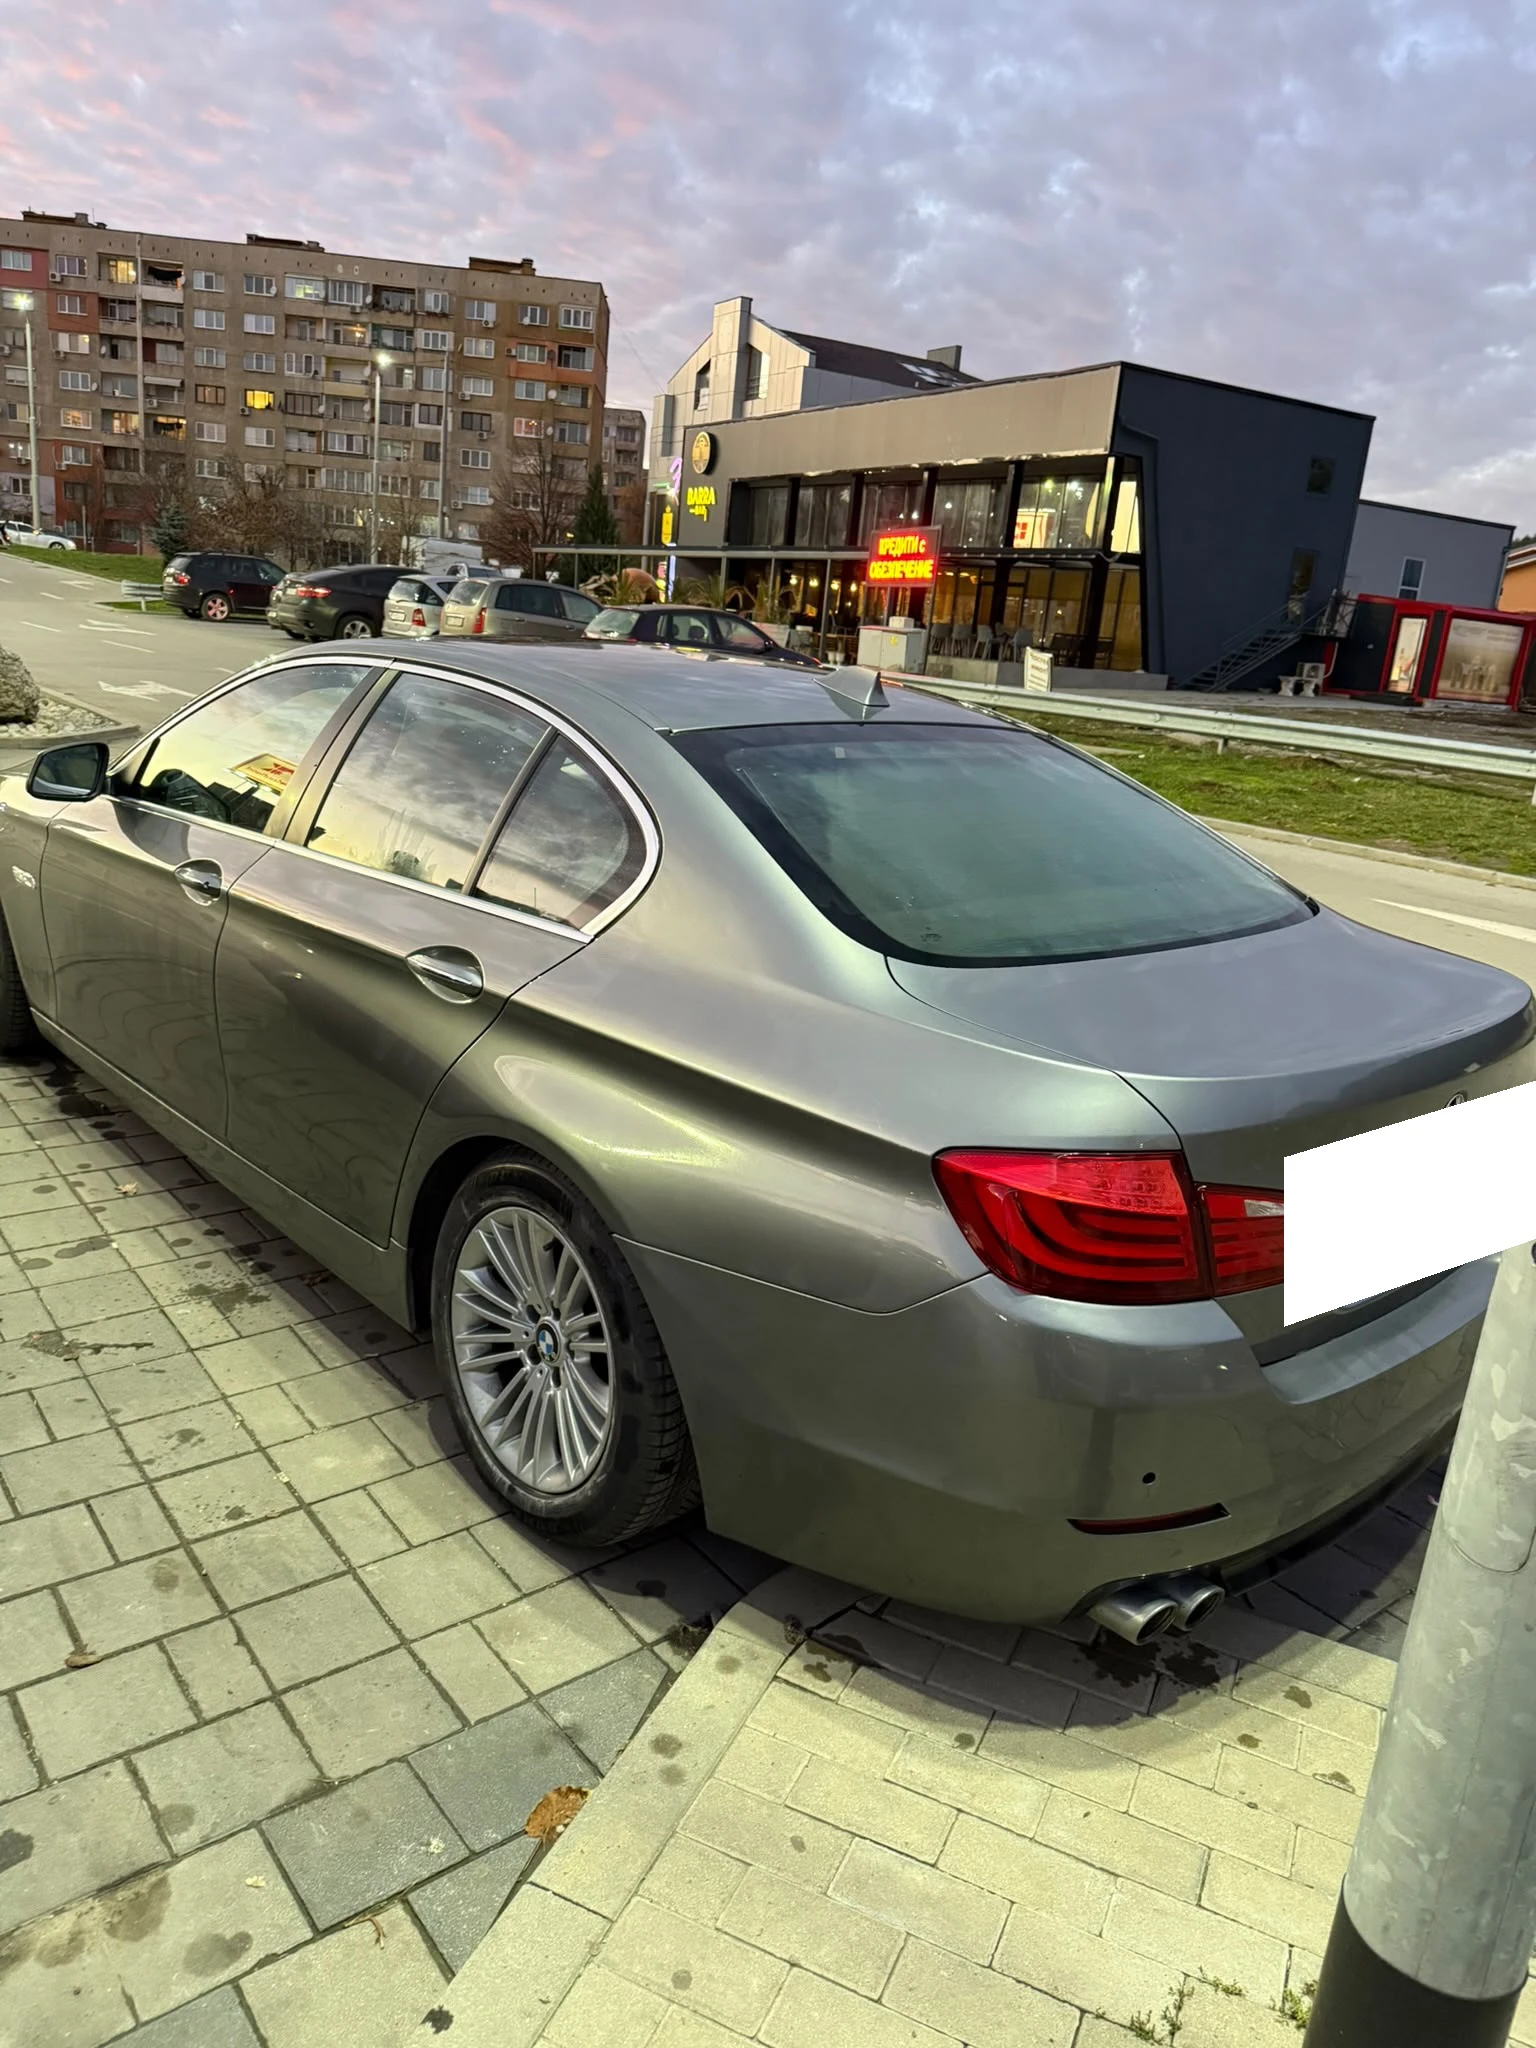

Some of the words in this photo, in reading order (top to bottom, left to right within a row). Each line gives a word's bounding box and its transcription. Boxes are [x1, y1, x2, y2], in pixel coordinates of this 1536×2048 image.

[687, 486, 716, 505] BARRA
[878, 535, 919, 557] КРЕДИТИ
[869, 559, 934, 579] ОБЕЗПЕЧЕНИЕ
